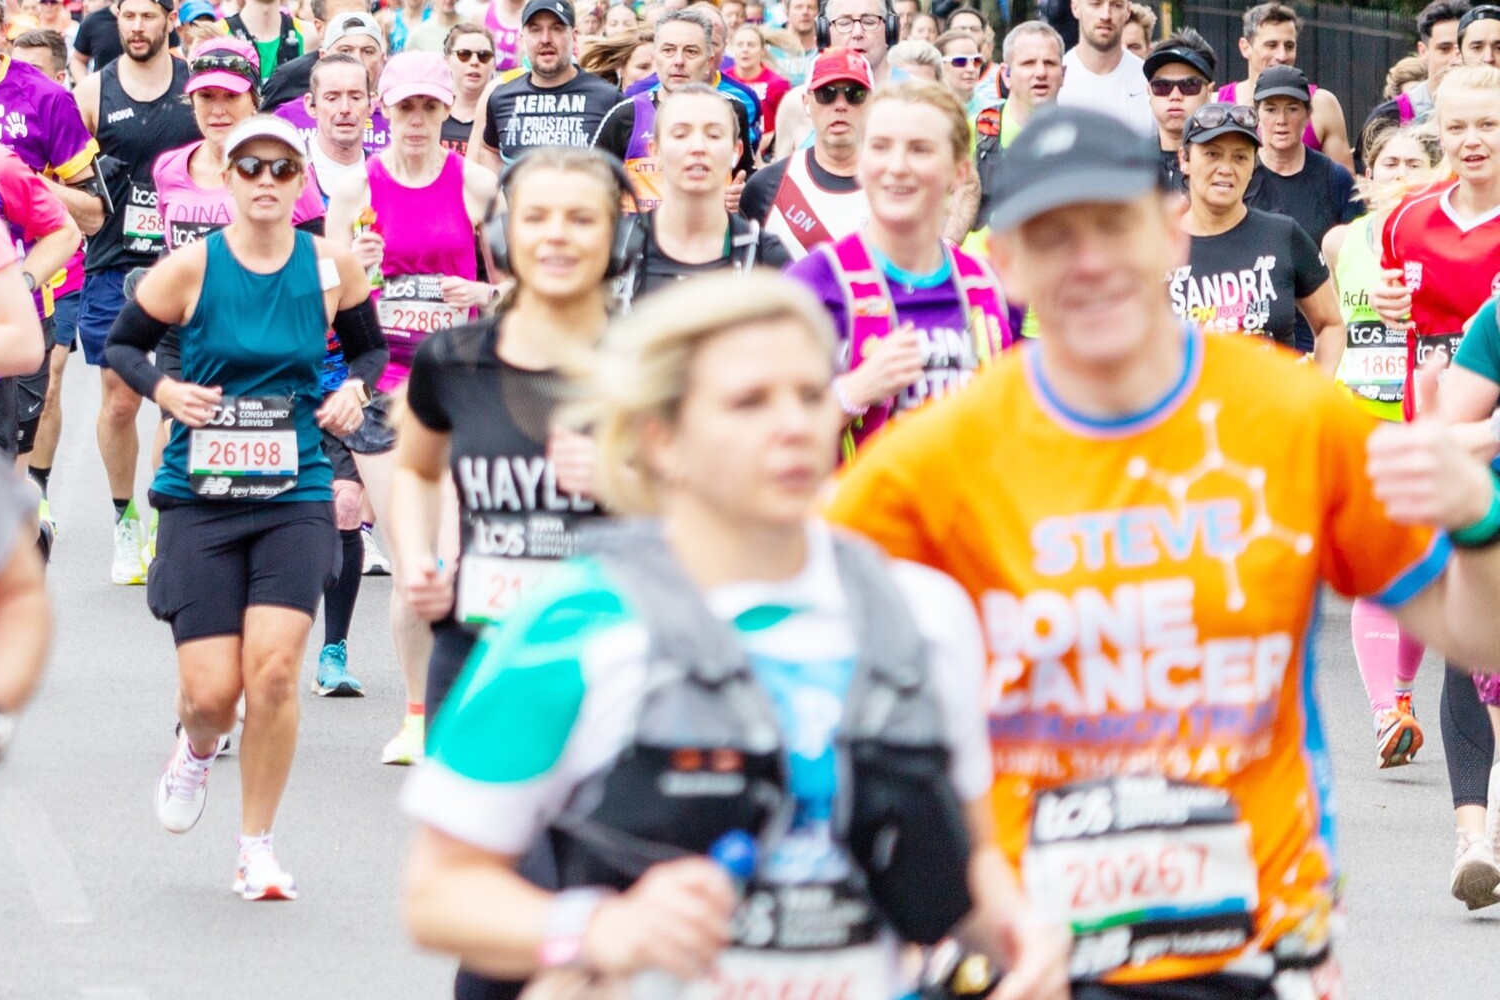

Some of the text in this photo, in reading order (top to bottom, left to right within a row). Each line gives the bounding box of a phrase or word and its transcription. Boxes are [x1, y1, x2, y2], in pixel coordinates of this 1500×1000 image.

[514, 94, 587, 114] KEIRAN
[107, 107, 135, 124] HOKA
[522, 116, 585, 133] PROSTATE
[520, 131, 590, 148] CANCER UK
[136, 213, 165, 232] 258
[784, 203, 817, 233] LDN
[384, 280, 417, 299] tcs
[1169, 267, 1278, 315] SANDRA
[1343, 288, 1369, 308] Ach
[393, 308, 454, 333] 22863
[1243, 314, 1270, 331] OF
[1350, 324, 1383, 345] tcs
[1361, 355, 1407, 377] 1869
[208, 405, 236, 427] cs
[239, 401, 264, 411] TATA
[239, 410, 290, 419] CONSULTANCY
[239, 419, 274, 428] SERVICES
[207, 441, 282, 467] 26198
[458, 455, 595, 512] HAYL
[1029, 498, 1246, 577] STEVE
[980, 577, 1197, 661] BONE
[987, 631, 1293, 715] CANCER
